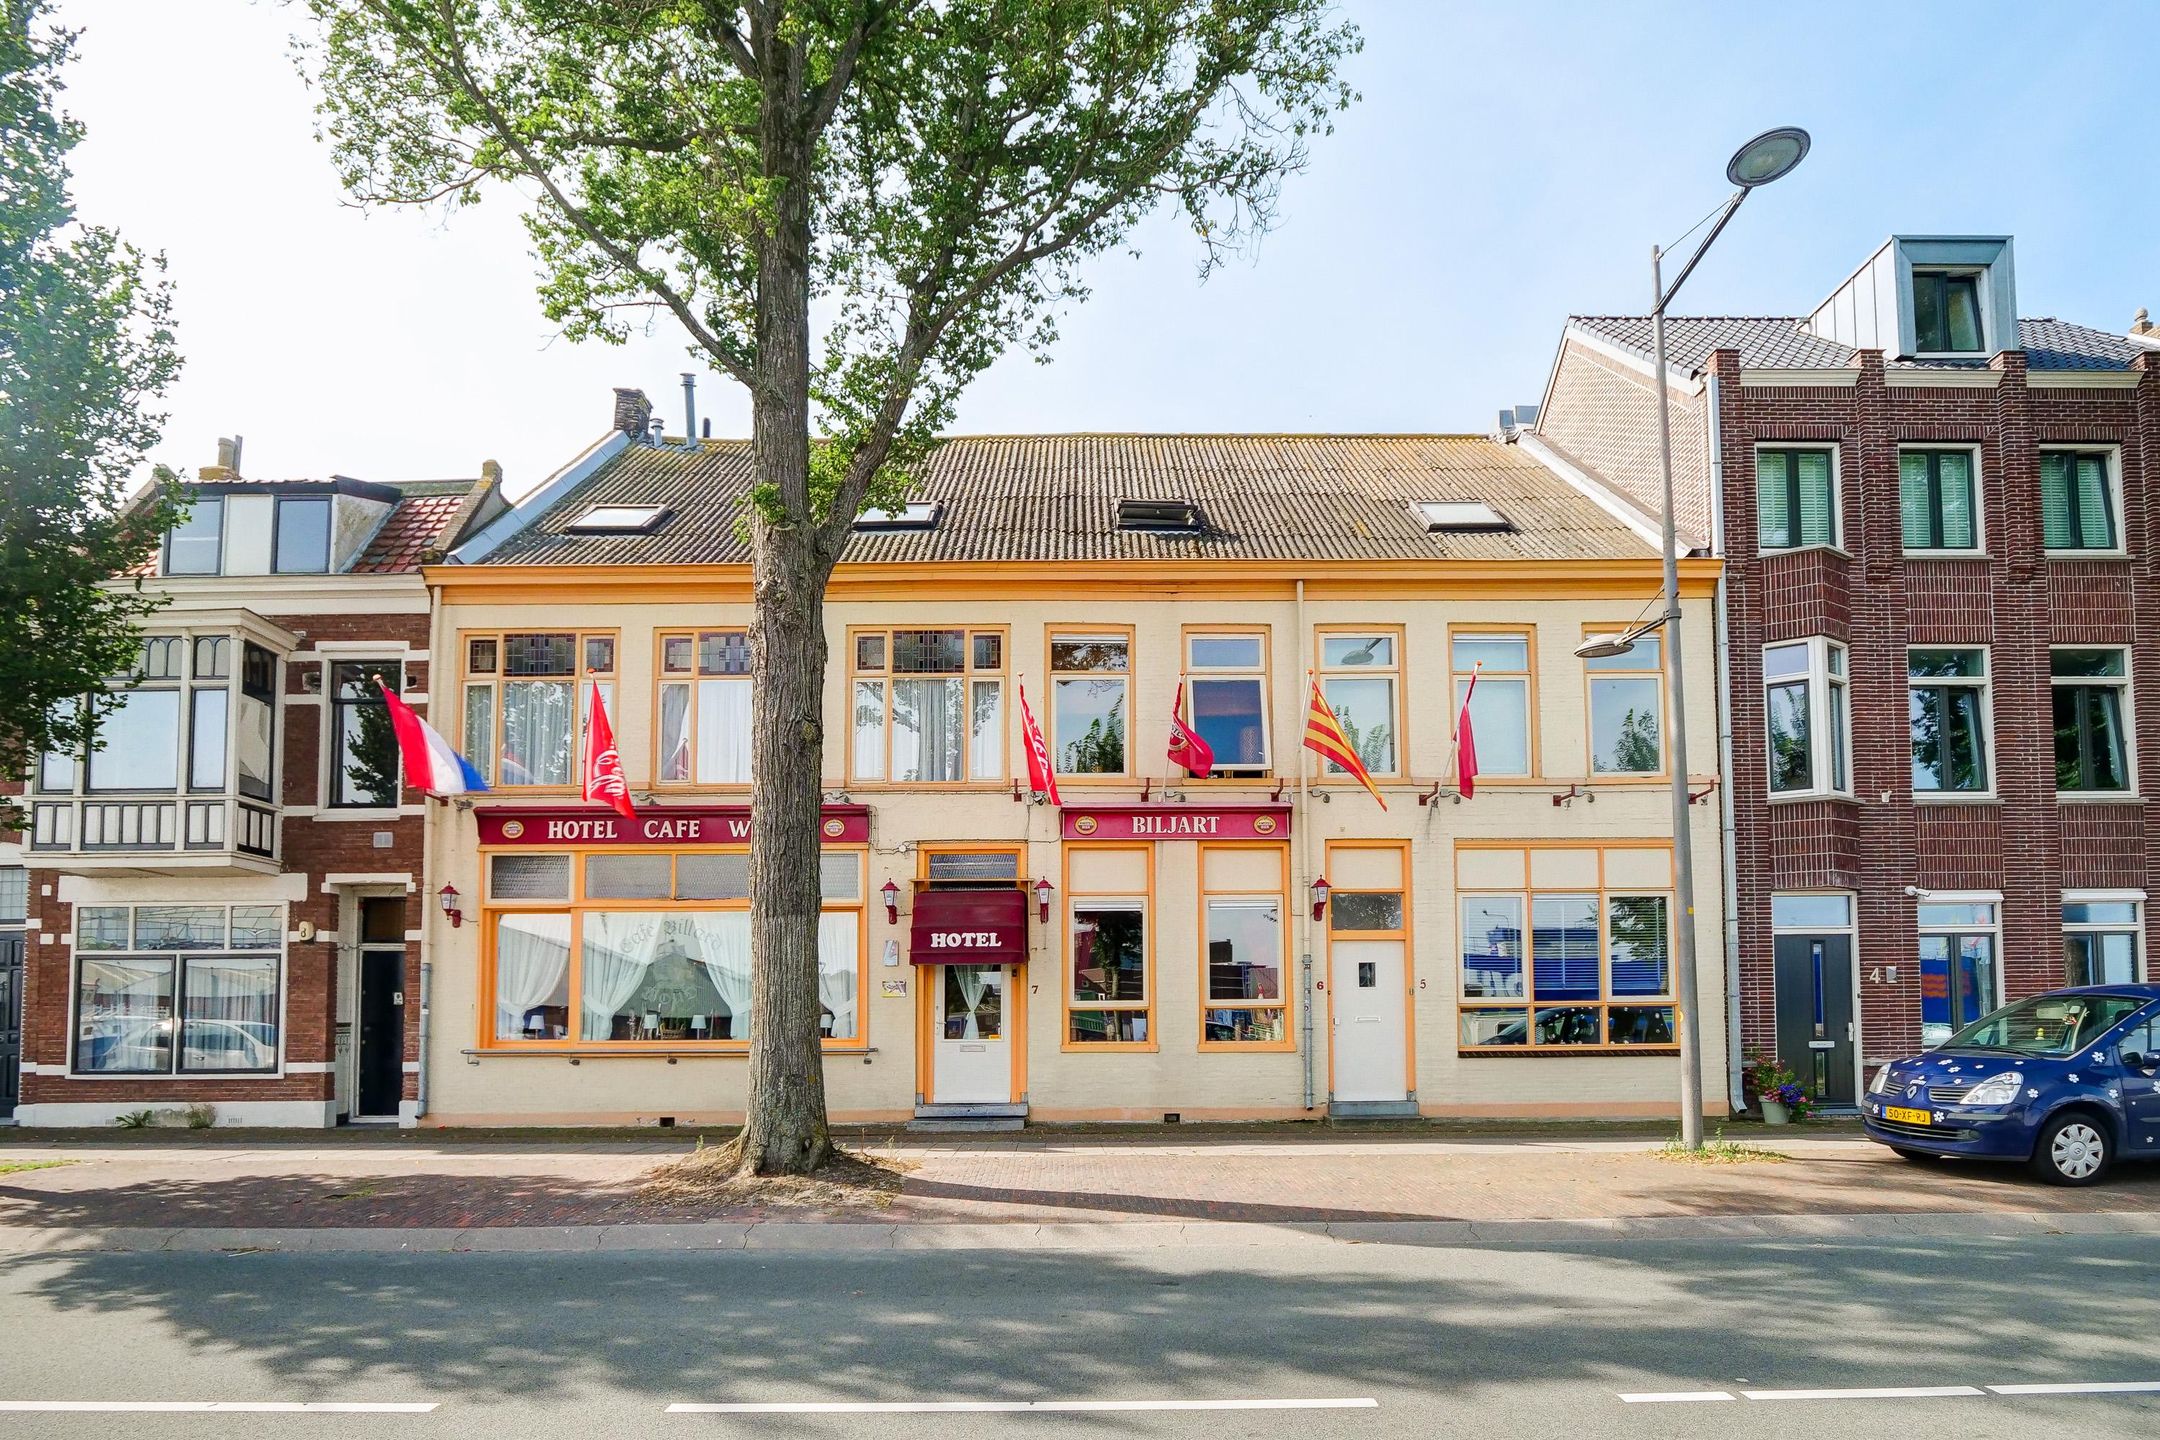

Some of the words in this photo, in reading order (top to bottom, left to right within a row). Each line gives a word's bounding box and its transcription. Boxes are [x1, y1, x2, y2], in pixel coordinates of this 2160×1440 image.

[547, 820, 618, 839] HOTEL
[643, 820, 700, 838] CAFE
[1131, 816, 1220, 834] BILJART
[930, 932, 1002, 948] HOTEL
[1869, 967, 1881, 984] 4
[1031, 985, 1039, 994] 7
[1316, 981, 1324, 990] 6
[1420, 979, 1427, 989] 5
